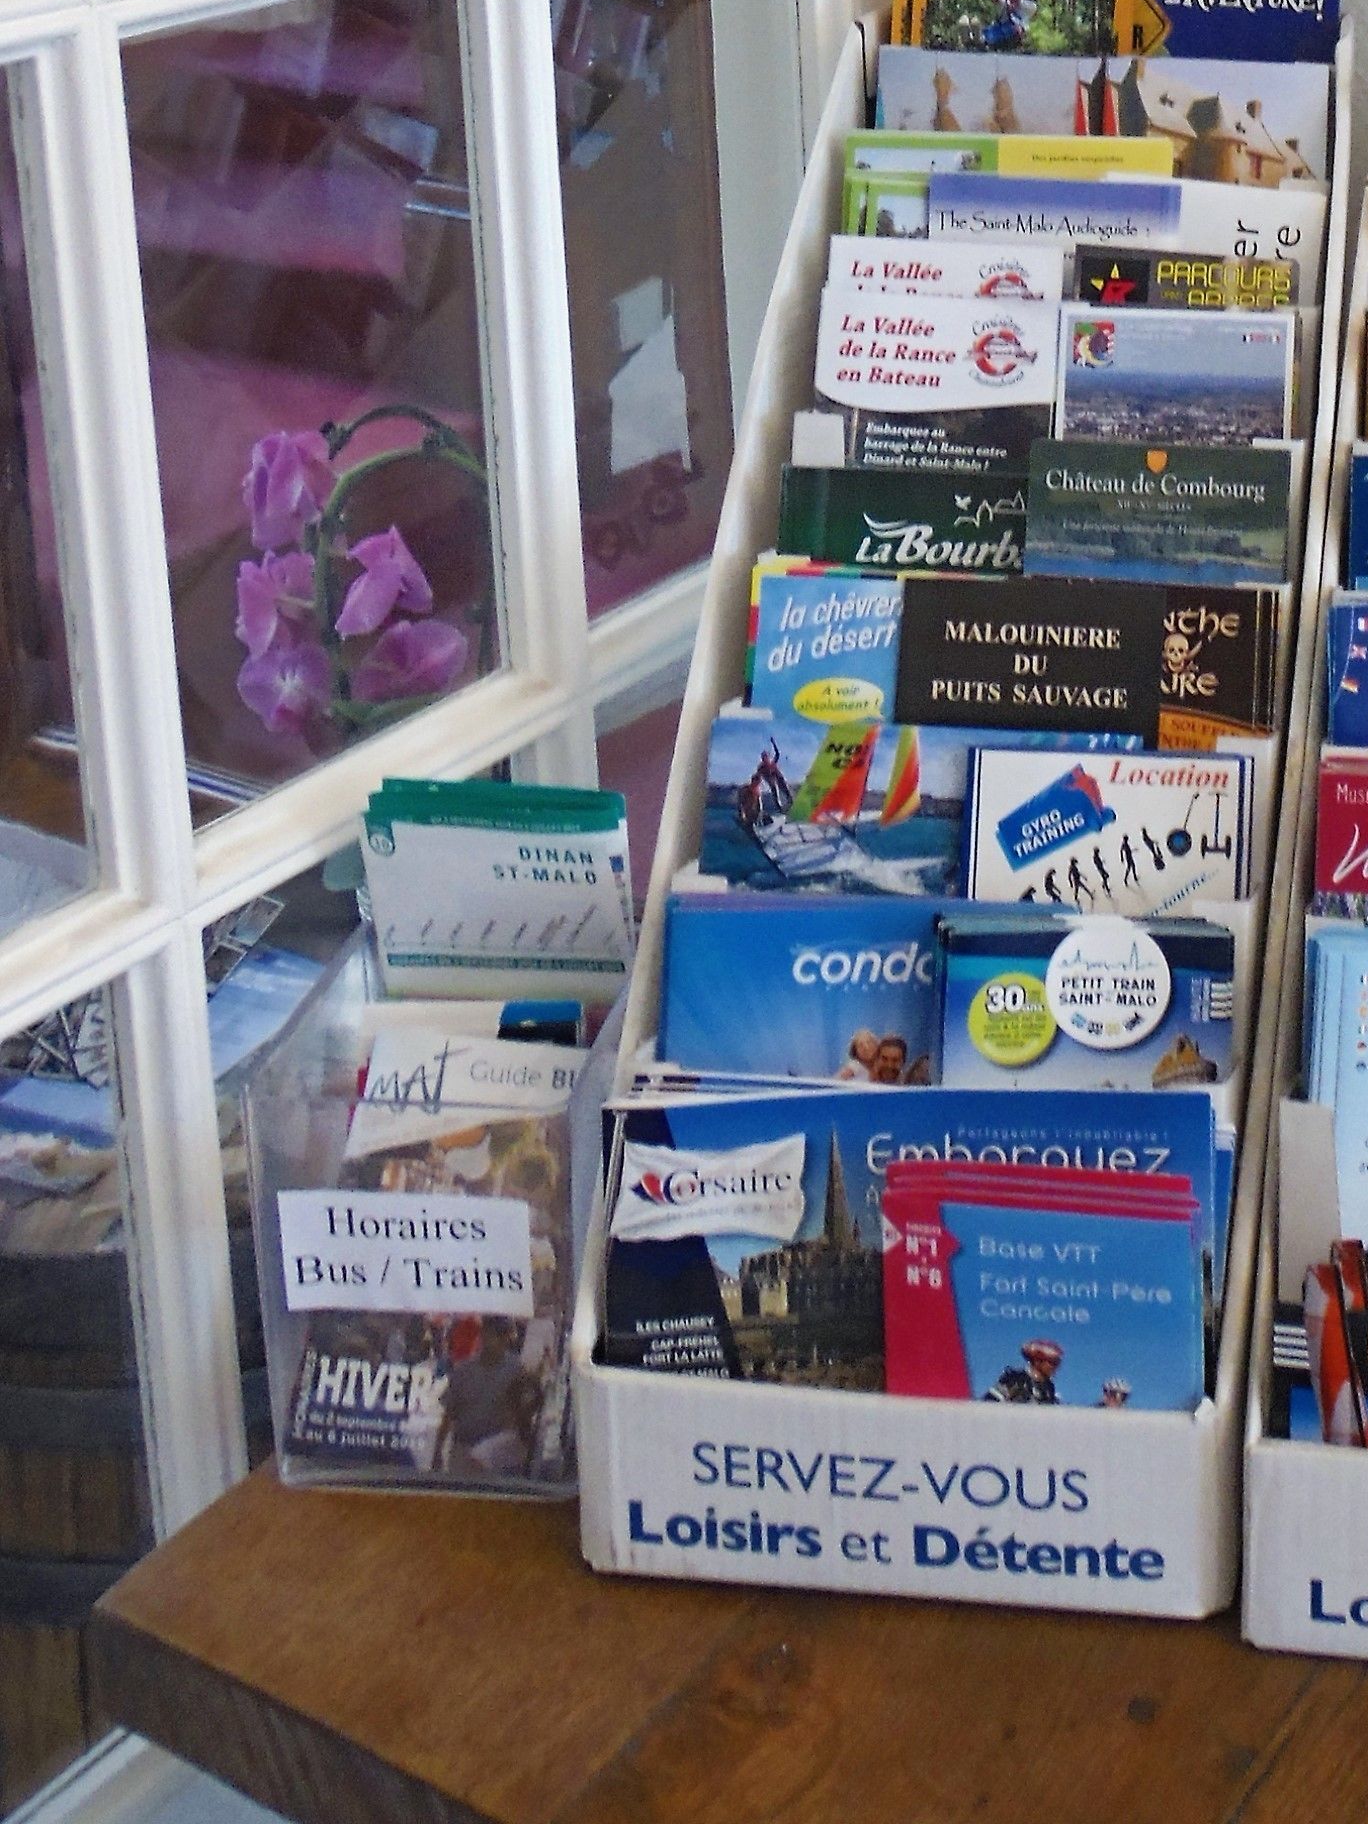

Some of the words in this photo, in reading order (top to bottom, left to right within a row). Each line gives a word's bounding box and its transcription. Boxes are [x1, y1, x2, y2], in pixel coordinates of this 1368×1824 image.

[937, 209, 967, 232] The
[1054, 215, 1140, 242] Audioguide
[851, 260, 876, 279] La
[882, 261, 944, 282] Vallée
[841, 314, 866, 333] La
[874, 315, 936, 337] Vallée
[838, 339, 864, 357] de
[868, 340, 888, 359] la
[895, 342, 957, 364] Rance
[836, 366, 862, 383] en
[868, 366, 942, 388] Bateau
[1044, 467, 1126, 497] Château
[1130, 472, 1155, 497] de
[1159, 472, 1266, 505] Combourg
[855, 535, 893, 564] La
[878, 518, 1023, 570] Bourb
[780, 596, 807, 632] la
[768, 635, 803, 673] du
[810, 620, 898, 660] désert
[944, 618, 1122, 652] MALOUINIERE
[1013, 654, 1050, 677] DU
[931, 679, 1002, 706] PUITS
[1012, 682, 1128, 710] SAUVAGE
[1108, 760, 1230, 789] Location
[1012, 812, 1086, 860] TRAINING
[1021, 808, 1062, 840] GYRO
[518, 845, 594, 866] DINAN
[491, 863, 598, 886] ST-MALO
[985, 983, 1026, 1015] 30
[1060, 976, 1103, 991] PETIT
[1111, 976, 1157, 992] TRAIN
[468, 1060, 544, 1087] Guide
[324, 1206, 488, 1242] Horaires
[978, 1235, 1045, 1259] Base
[1052, 1243, 1102, 1264] VTT
[294, 1255, 369, 1287] Bus
[402, 1257, 525, 1294] Trains
[979, 1271, 1029, 1298] Fort
[980, 1297, 1092, 1325] Cancale
[691, 1441, 1090, 1513] SERVEZ-VOUS
[627, 1498, 824, 1559] Loisirs
[839, 1531, 892, 1565] et
[912, 1522, 1167, 1580] Détente
